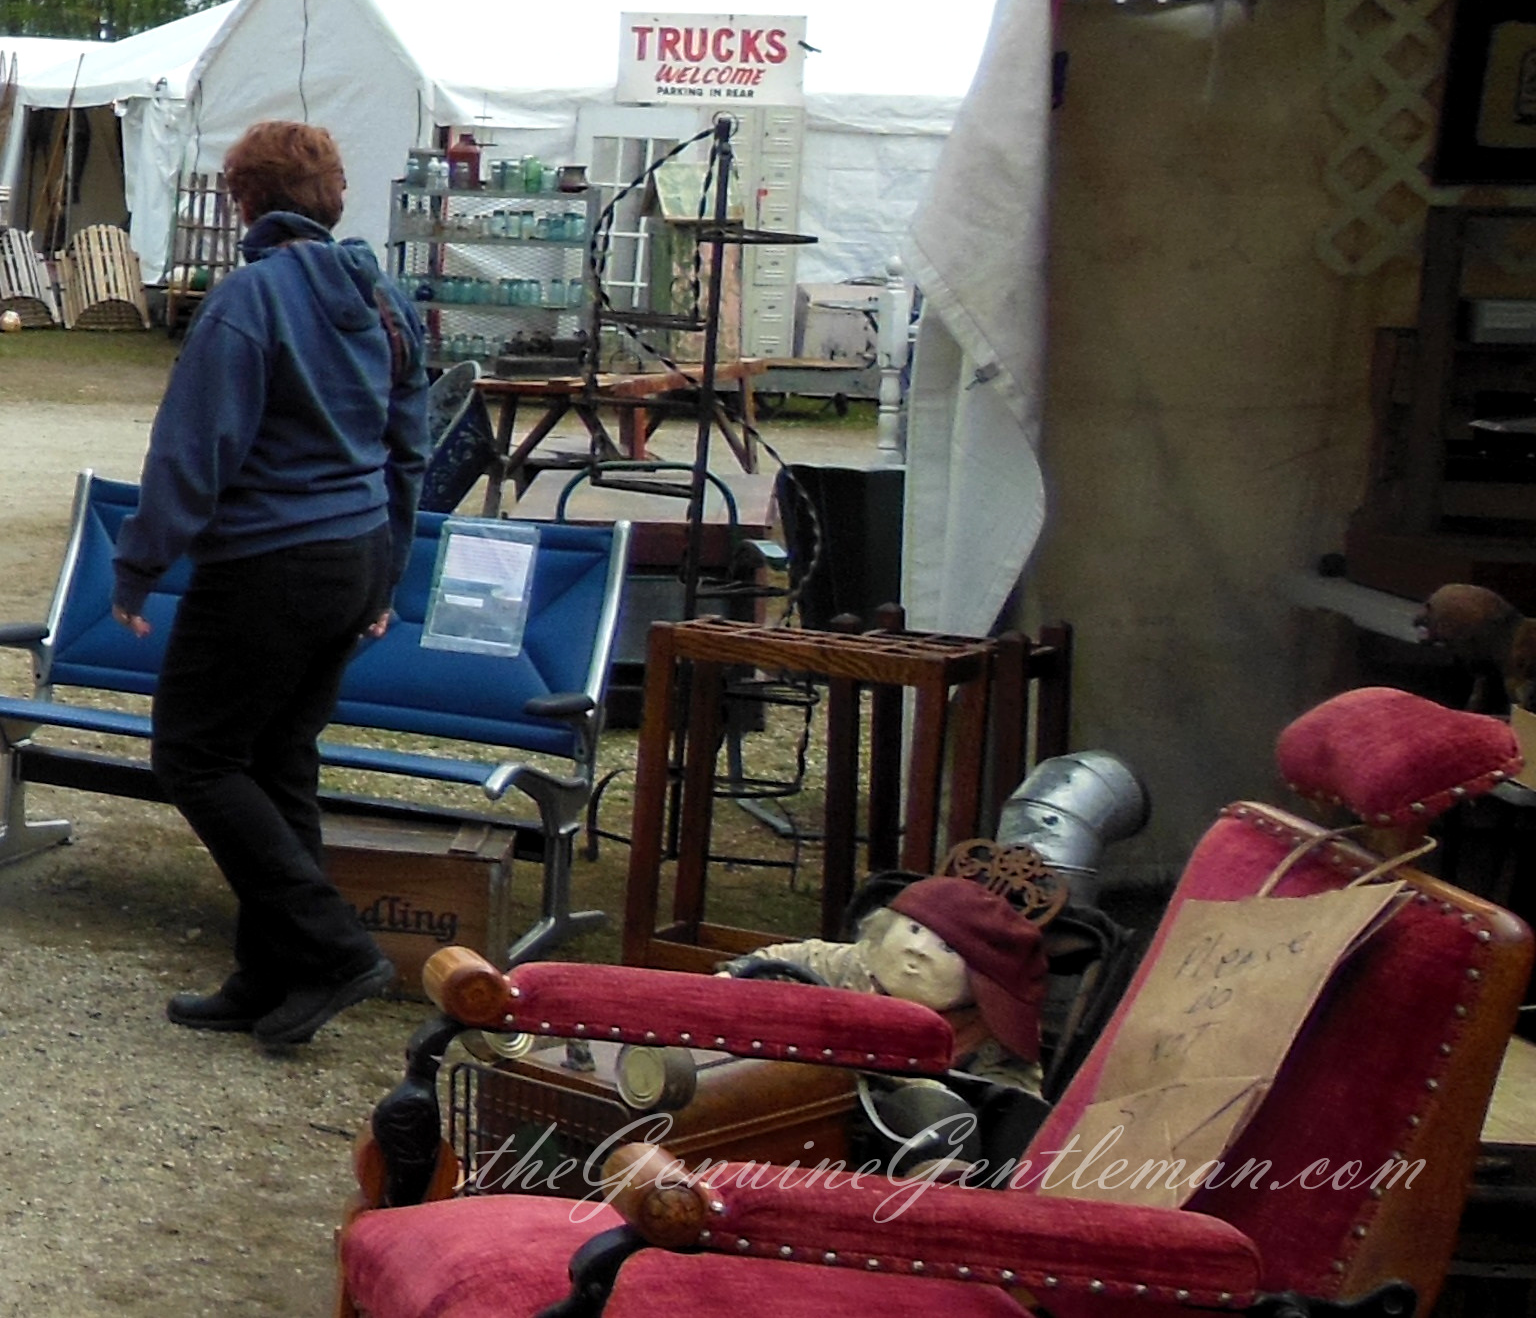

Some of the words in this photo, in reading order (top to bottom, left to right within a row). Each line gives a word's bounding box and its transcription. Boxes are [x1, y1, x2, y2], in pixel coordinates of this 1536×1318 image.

[631, 26, 787, 64] TRUCKS
[655, 63, 766, 86] WELCOME
[657, 86, 704, 97] PARKING
[709, 87, 722, 97] IN
[726, 88, 754, 98] REAR
[346, 895, 459, 943] dling
